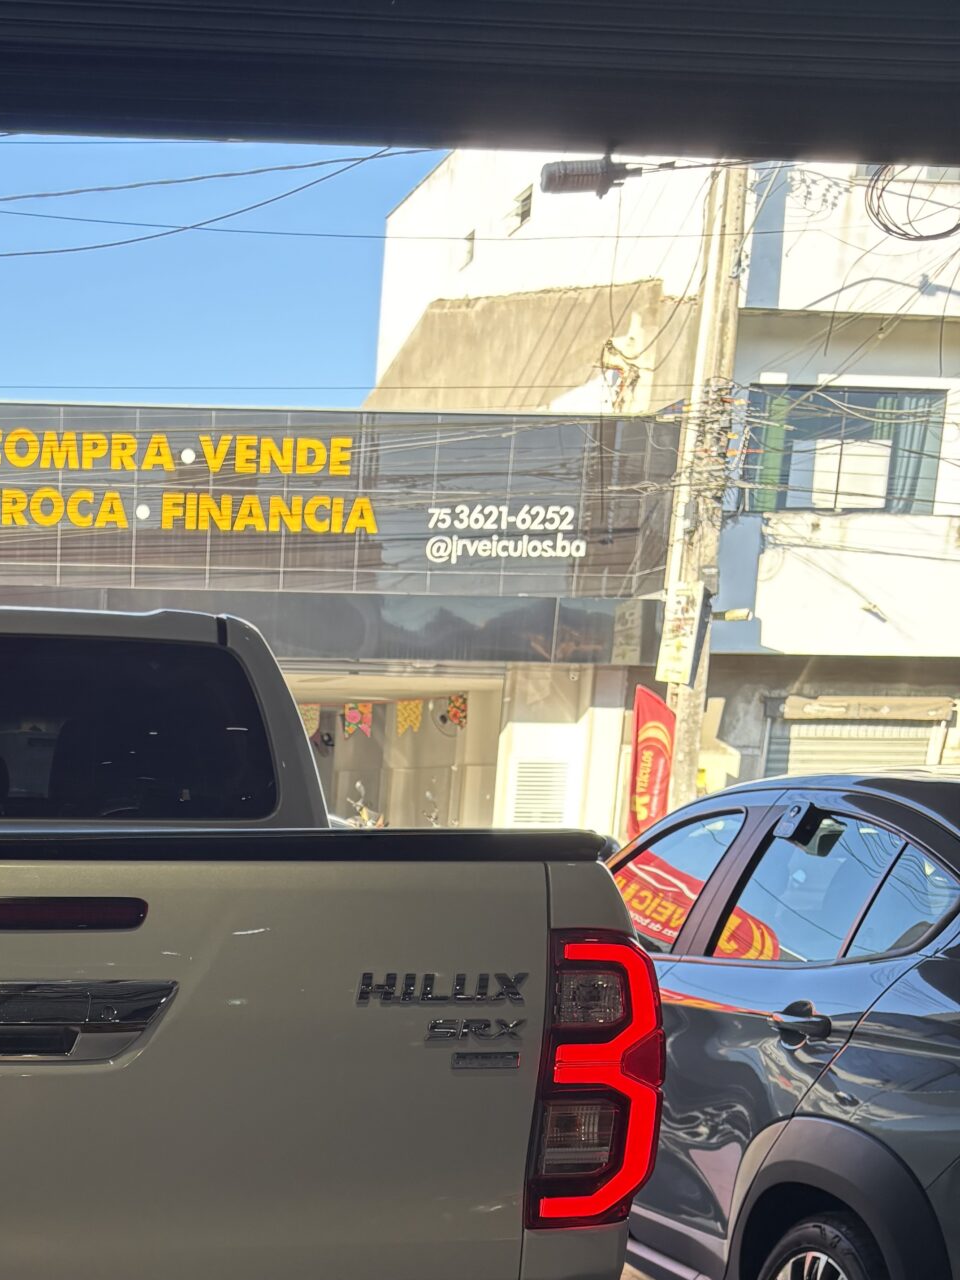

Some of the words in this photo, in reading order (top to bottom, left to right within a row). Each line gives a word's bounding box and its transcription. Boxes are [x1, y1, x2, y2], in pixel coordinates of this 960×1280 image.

[199, 434, 353, 476] VENDE
[161, 491, 378, 535] FINANCIA
[427, 507, 452, 530] 75
[453, 503, 575, 531] 3621-6252
[425, 531, 587, 565] @jrveiculos.ba
[356, 972, 529, 1004] HILUX
[425, 1018, 525, 1041] SRX
